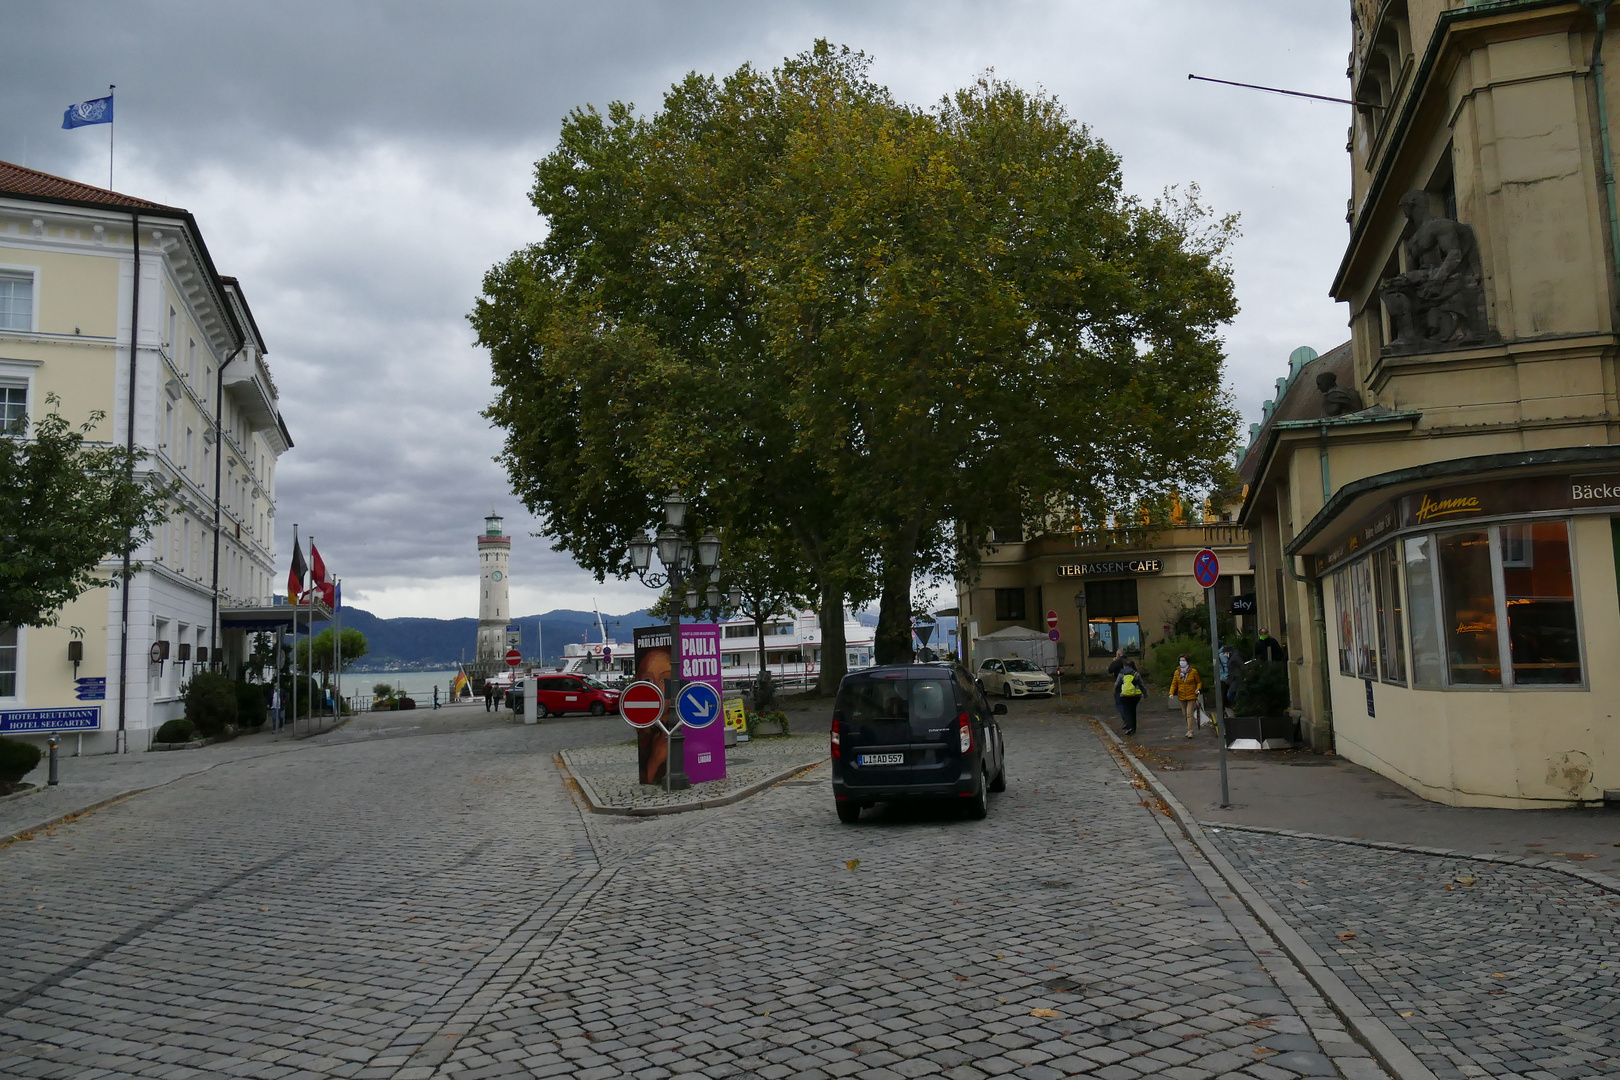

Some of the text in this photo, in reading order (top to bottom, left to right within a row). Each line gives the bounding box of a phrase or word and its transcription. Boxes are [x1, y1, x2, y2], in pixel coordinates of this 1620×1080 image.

[1416, 494, 1481, 524] Hamma
[1233, 599, 1252, 610] sky
[681, 637, 717, 656] PAULA
[682, 657, 718, 677] &OTTO
[8, 710, 93, 721] HOTEL REUTEMANN
[10, 719, 91, 730] HOTEL SEEGARTEN
[863, 754, 902, 764] LI AD 557
